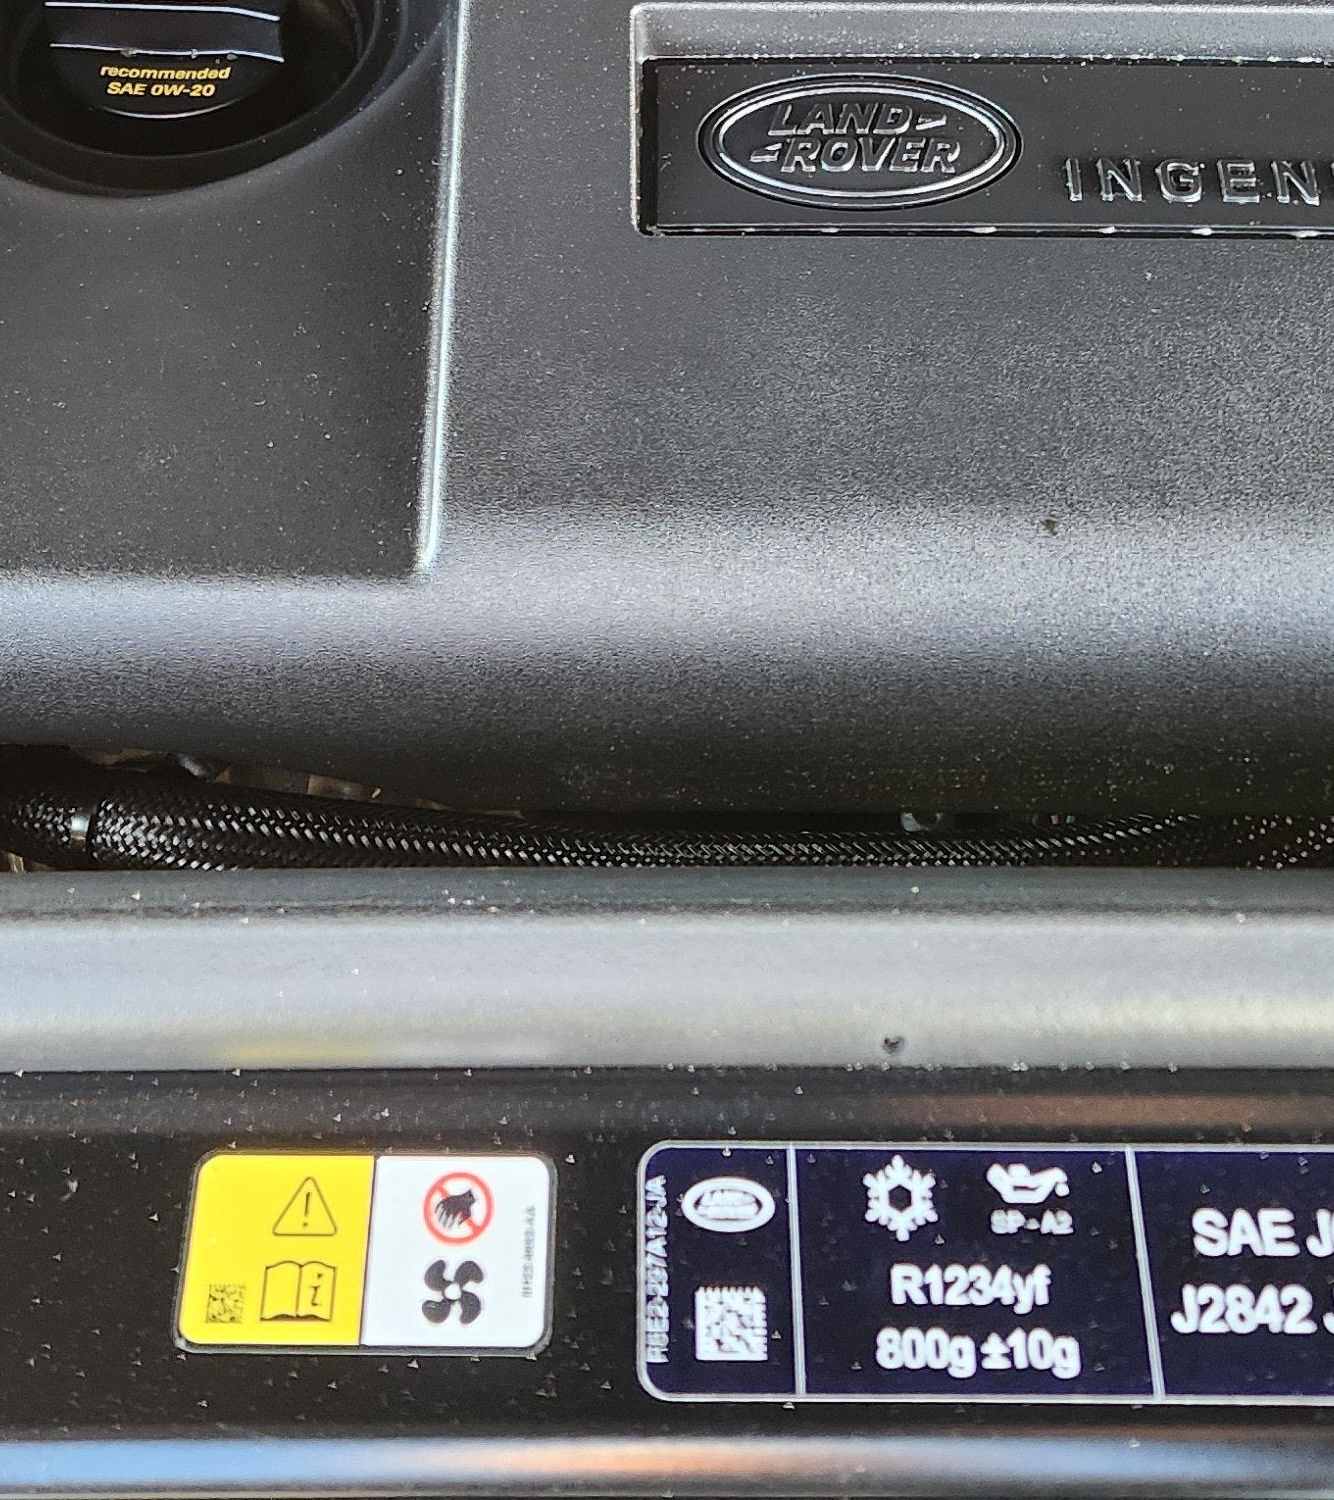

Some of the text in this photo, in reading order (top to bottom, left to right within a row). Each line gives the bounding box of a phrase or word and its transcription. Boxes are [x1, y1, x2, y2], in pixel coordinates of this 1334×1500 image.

[100, 64, 231, 80] recommended
[107, 82, 216, 97] SAE 0W-20
[1192, 1207, 1301, 1257] SAE
[890, 1263, 1052, 1315] R1234yf
[1170, 1283, 1318, 1334] J2842
[875, 1326, 1082, 1380] 800g ±10g
